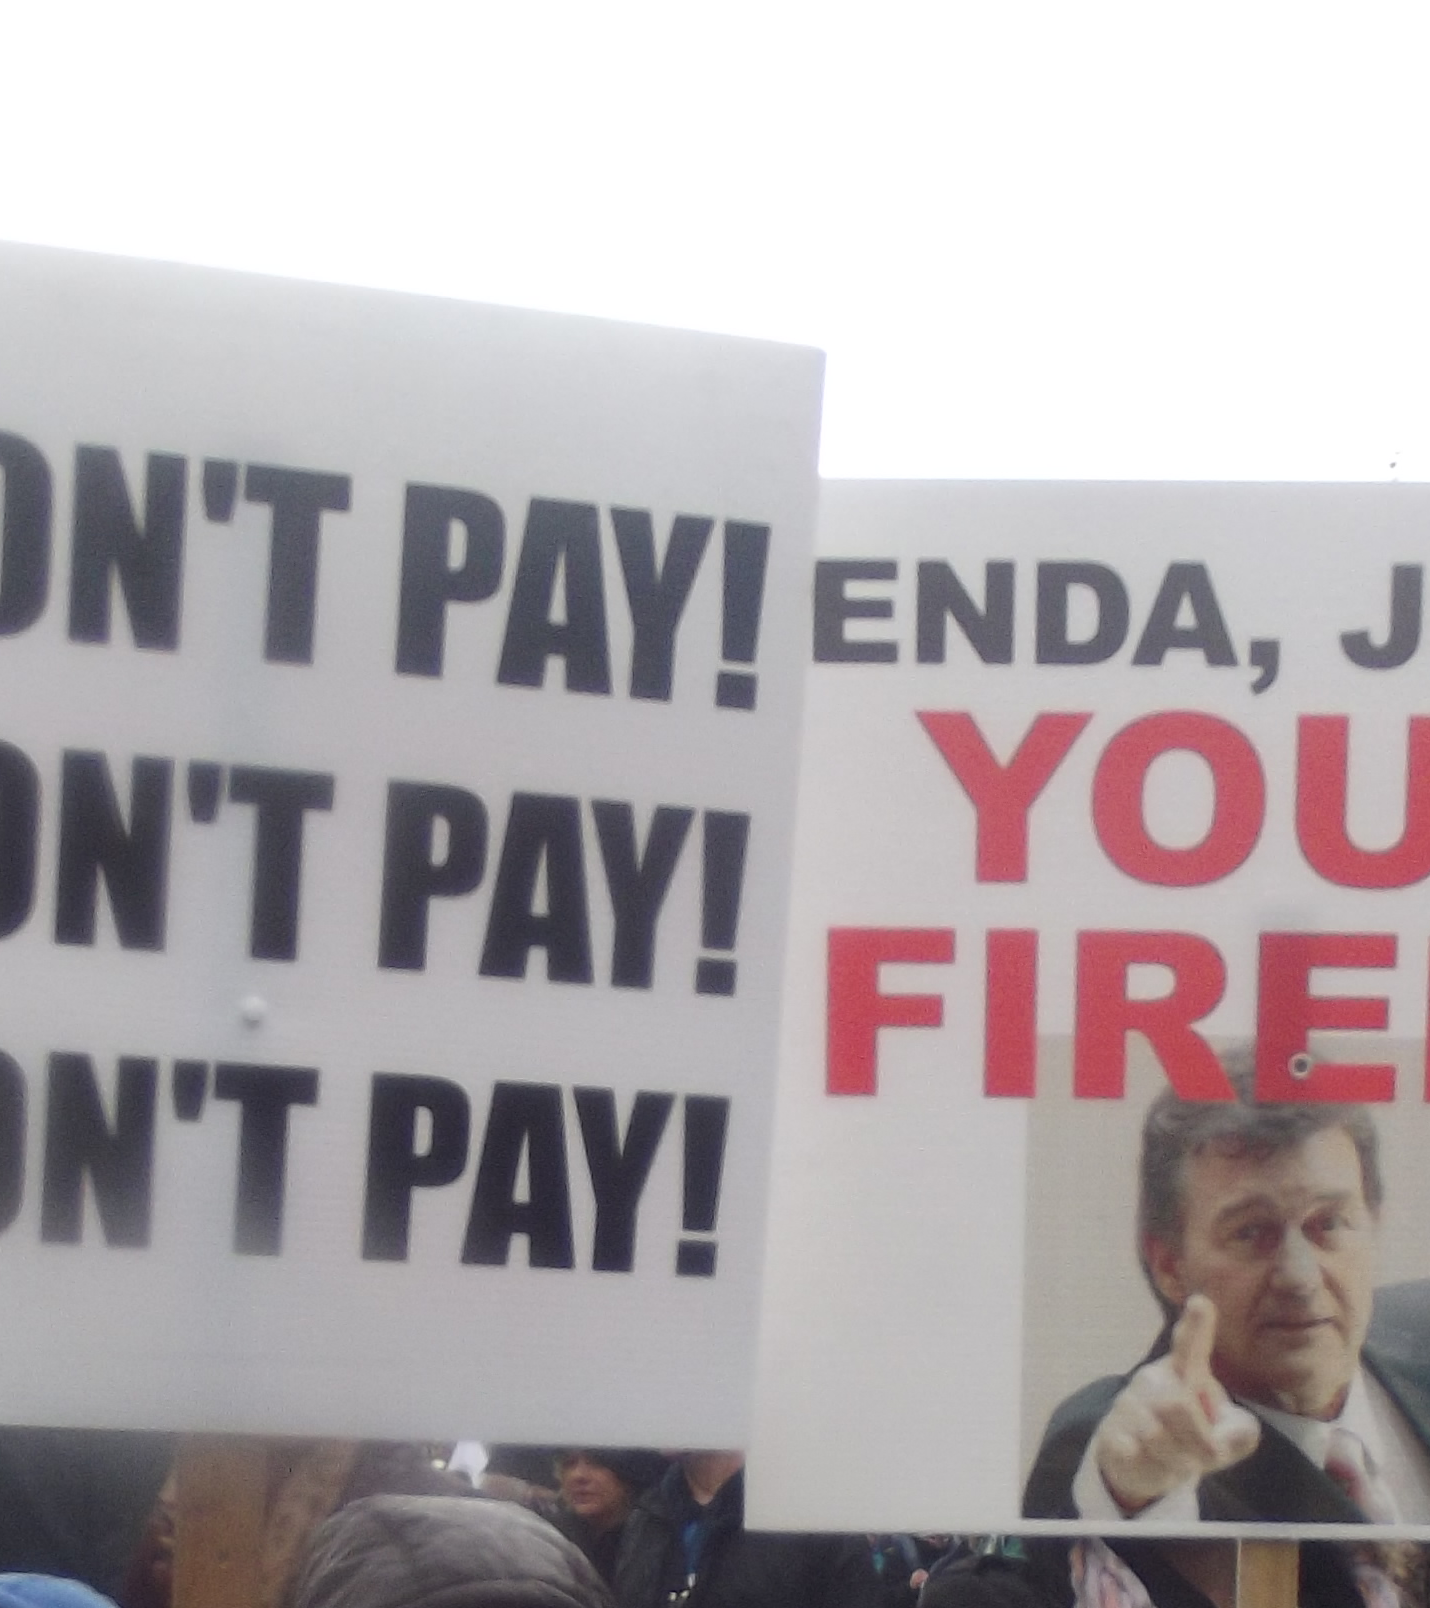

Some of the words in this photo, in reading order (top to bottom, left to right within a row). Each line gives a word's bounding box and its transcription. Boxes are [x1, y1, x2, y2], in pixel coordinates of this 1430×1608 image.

[392, 482, 771, 710] PAY!
[812, 560, 1280, 694] ENDA,
[377, 780, 751, 998] PAY!
[361, 1071, 731, 1278] PAY!
